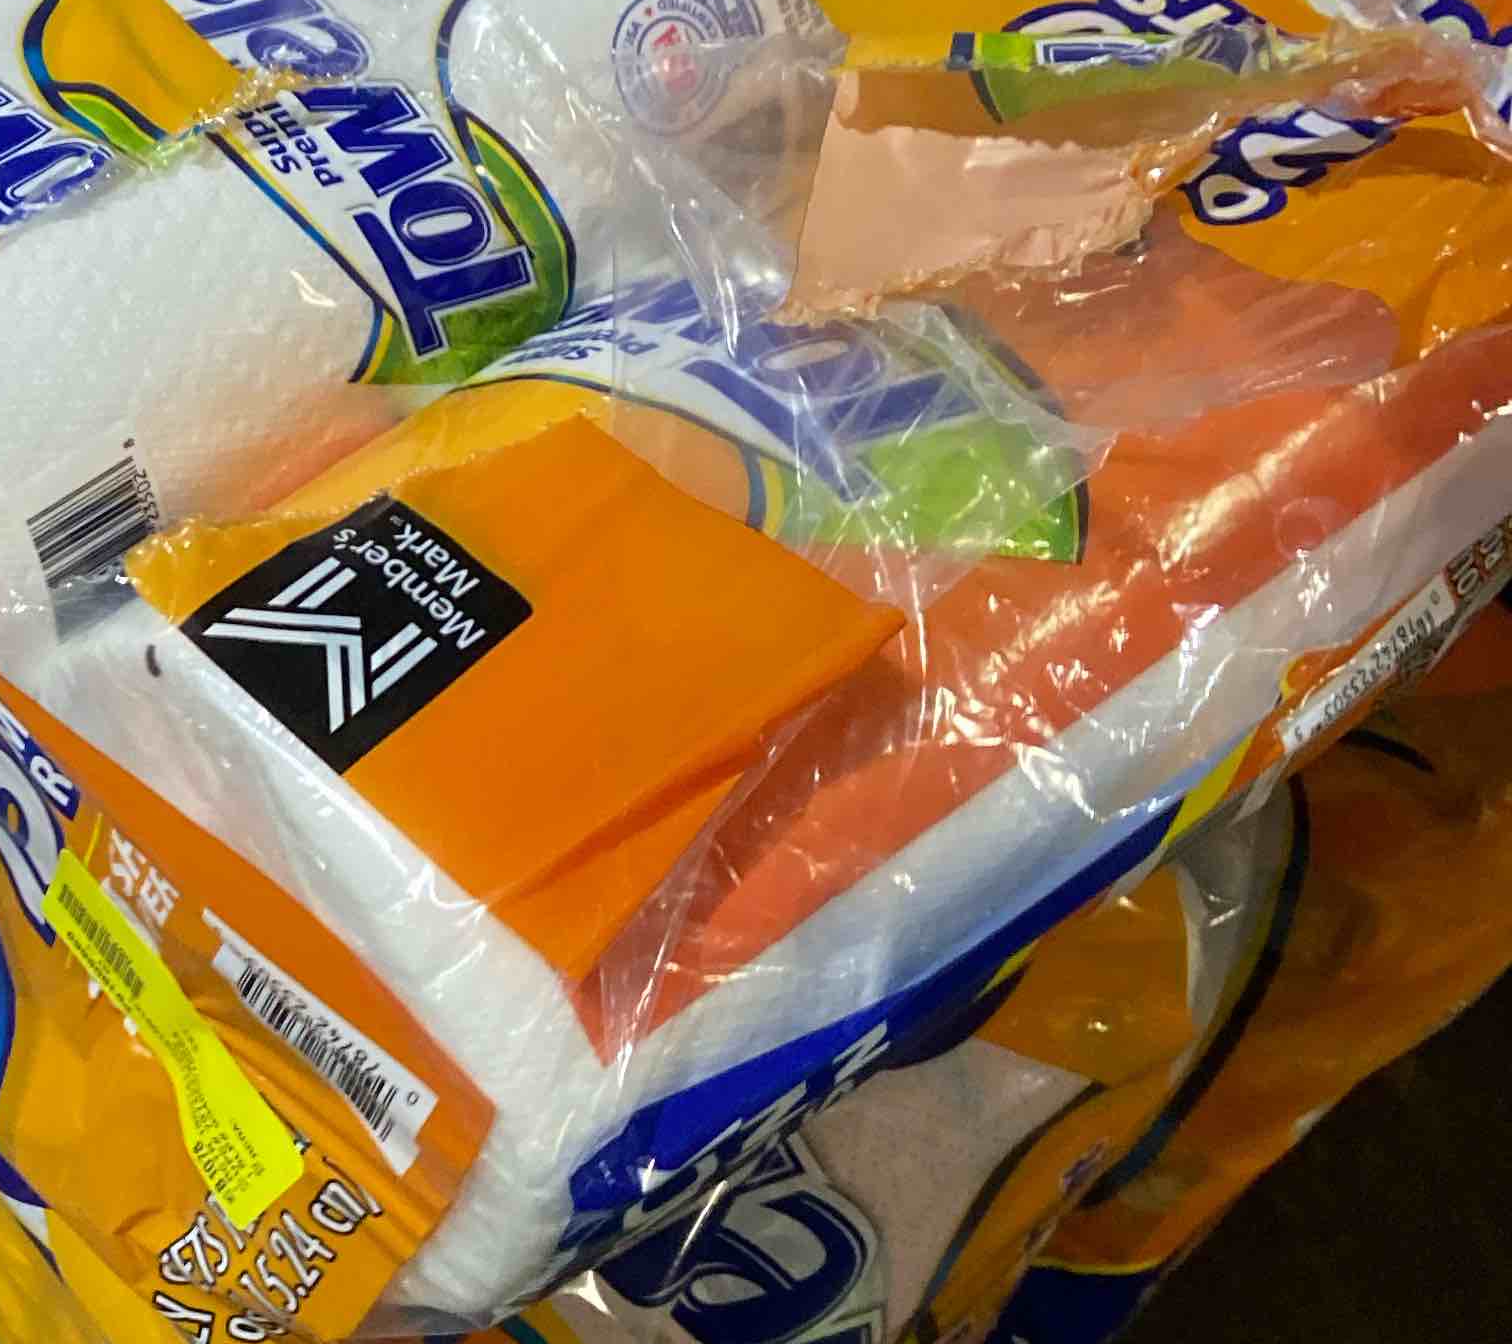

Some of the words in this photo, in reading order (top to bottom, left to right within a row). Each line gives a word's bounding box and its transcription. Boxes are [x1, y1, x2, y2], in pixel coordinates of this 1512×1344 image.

[235, 107, 302, 175] Supe
[265, 102, 345, 190] Premi
[333, 526, 487, 651] Member's
